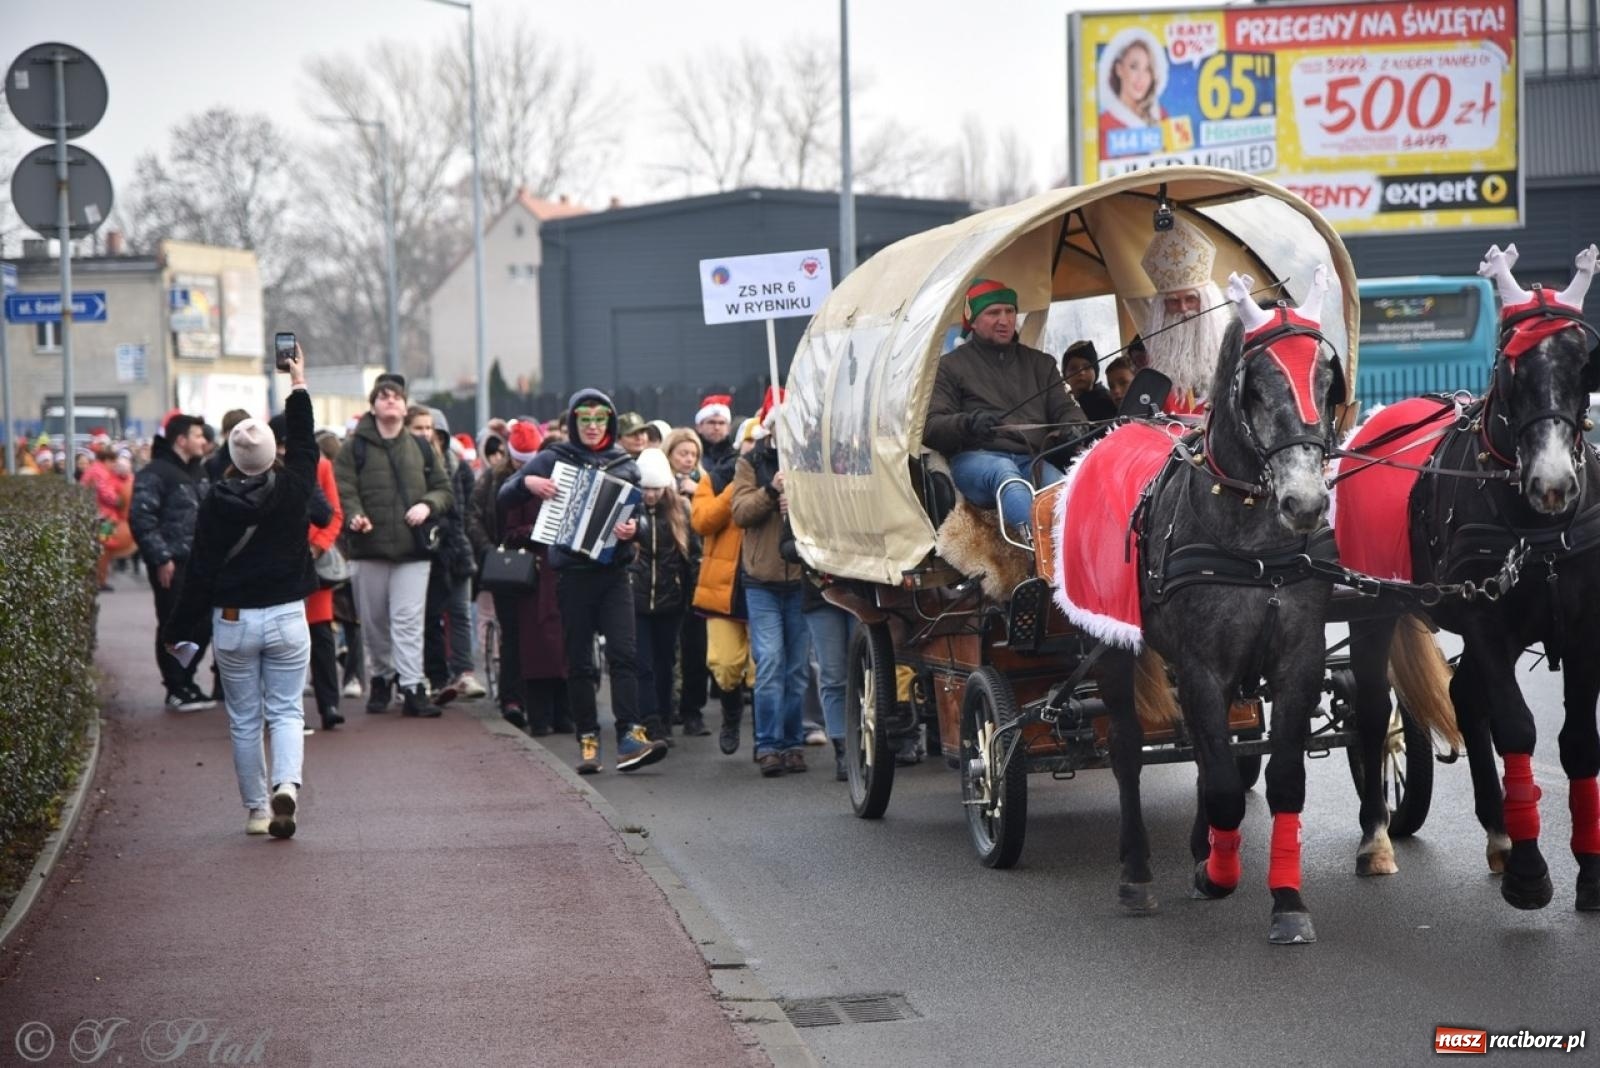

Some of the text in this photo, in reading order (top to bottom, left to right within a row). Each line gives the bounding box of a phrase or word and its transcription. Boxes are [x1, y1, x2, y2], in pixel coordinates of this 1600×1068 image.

[1236, 5, 1506, 45] PRZECENY NA ŚWIĘTA!
[1303, 72, 1453, 135] -500
[1385, 176, 1477, 208] expert
[738, 281, 796, 298] ZS NR 6
[725, 297, 811, 315] W RYBNIKU
